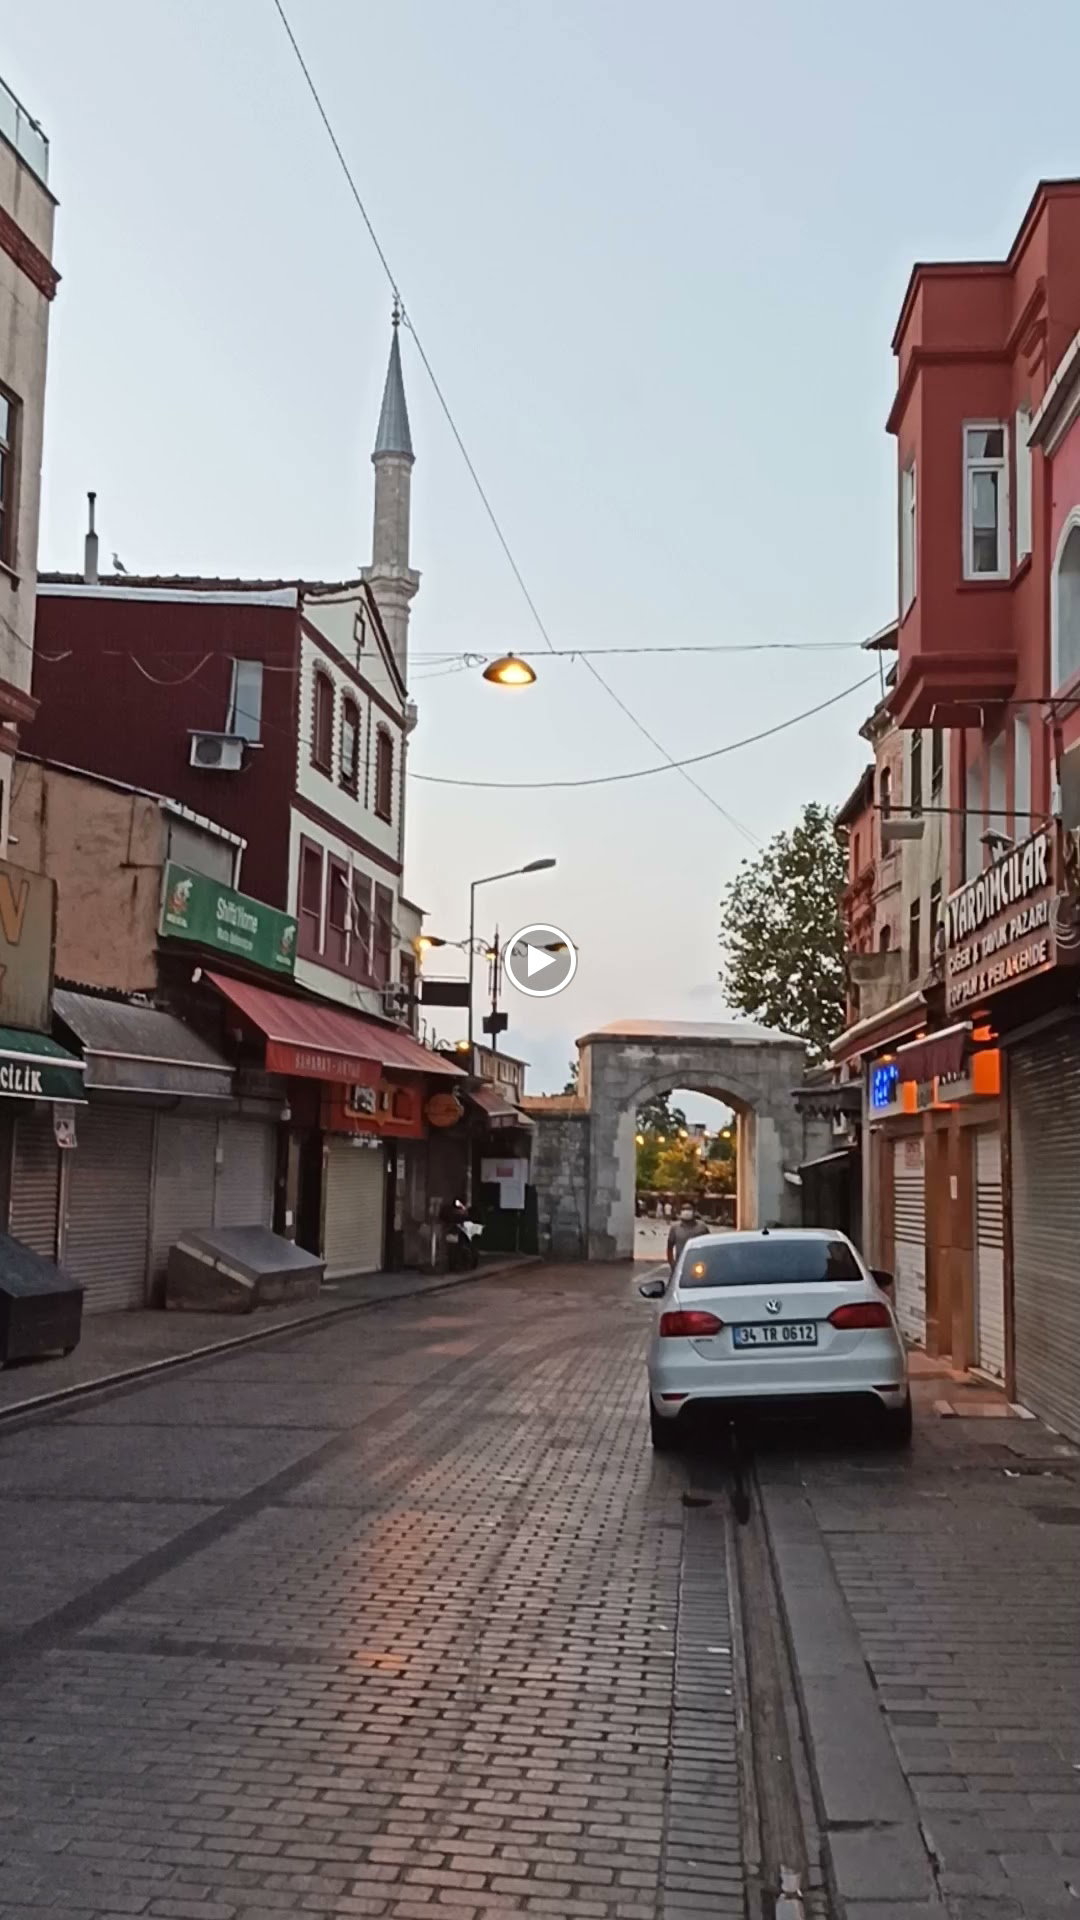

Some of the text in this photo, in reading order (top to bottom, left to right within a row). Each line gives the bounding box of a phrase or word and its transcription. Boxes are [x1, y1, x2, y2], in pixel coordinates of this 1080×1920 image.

[951, 834, 1048, 942] YARDIMCILAR
[1010, 900, 1048, 942] PAZARI
[987, 939, 1047, 990] PERAKENDE
[741, 1325, 813, 1343] 34 TR 0612
